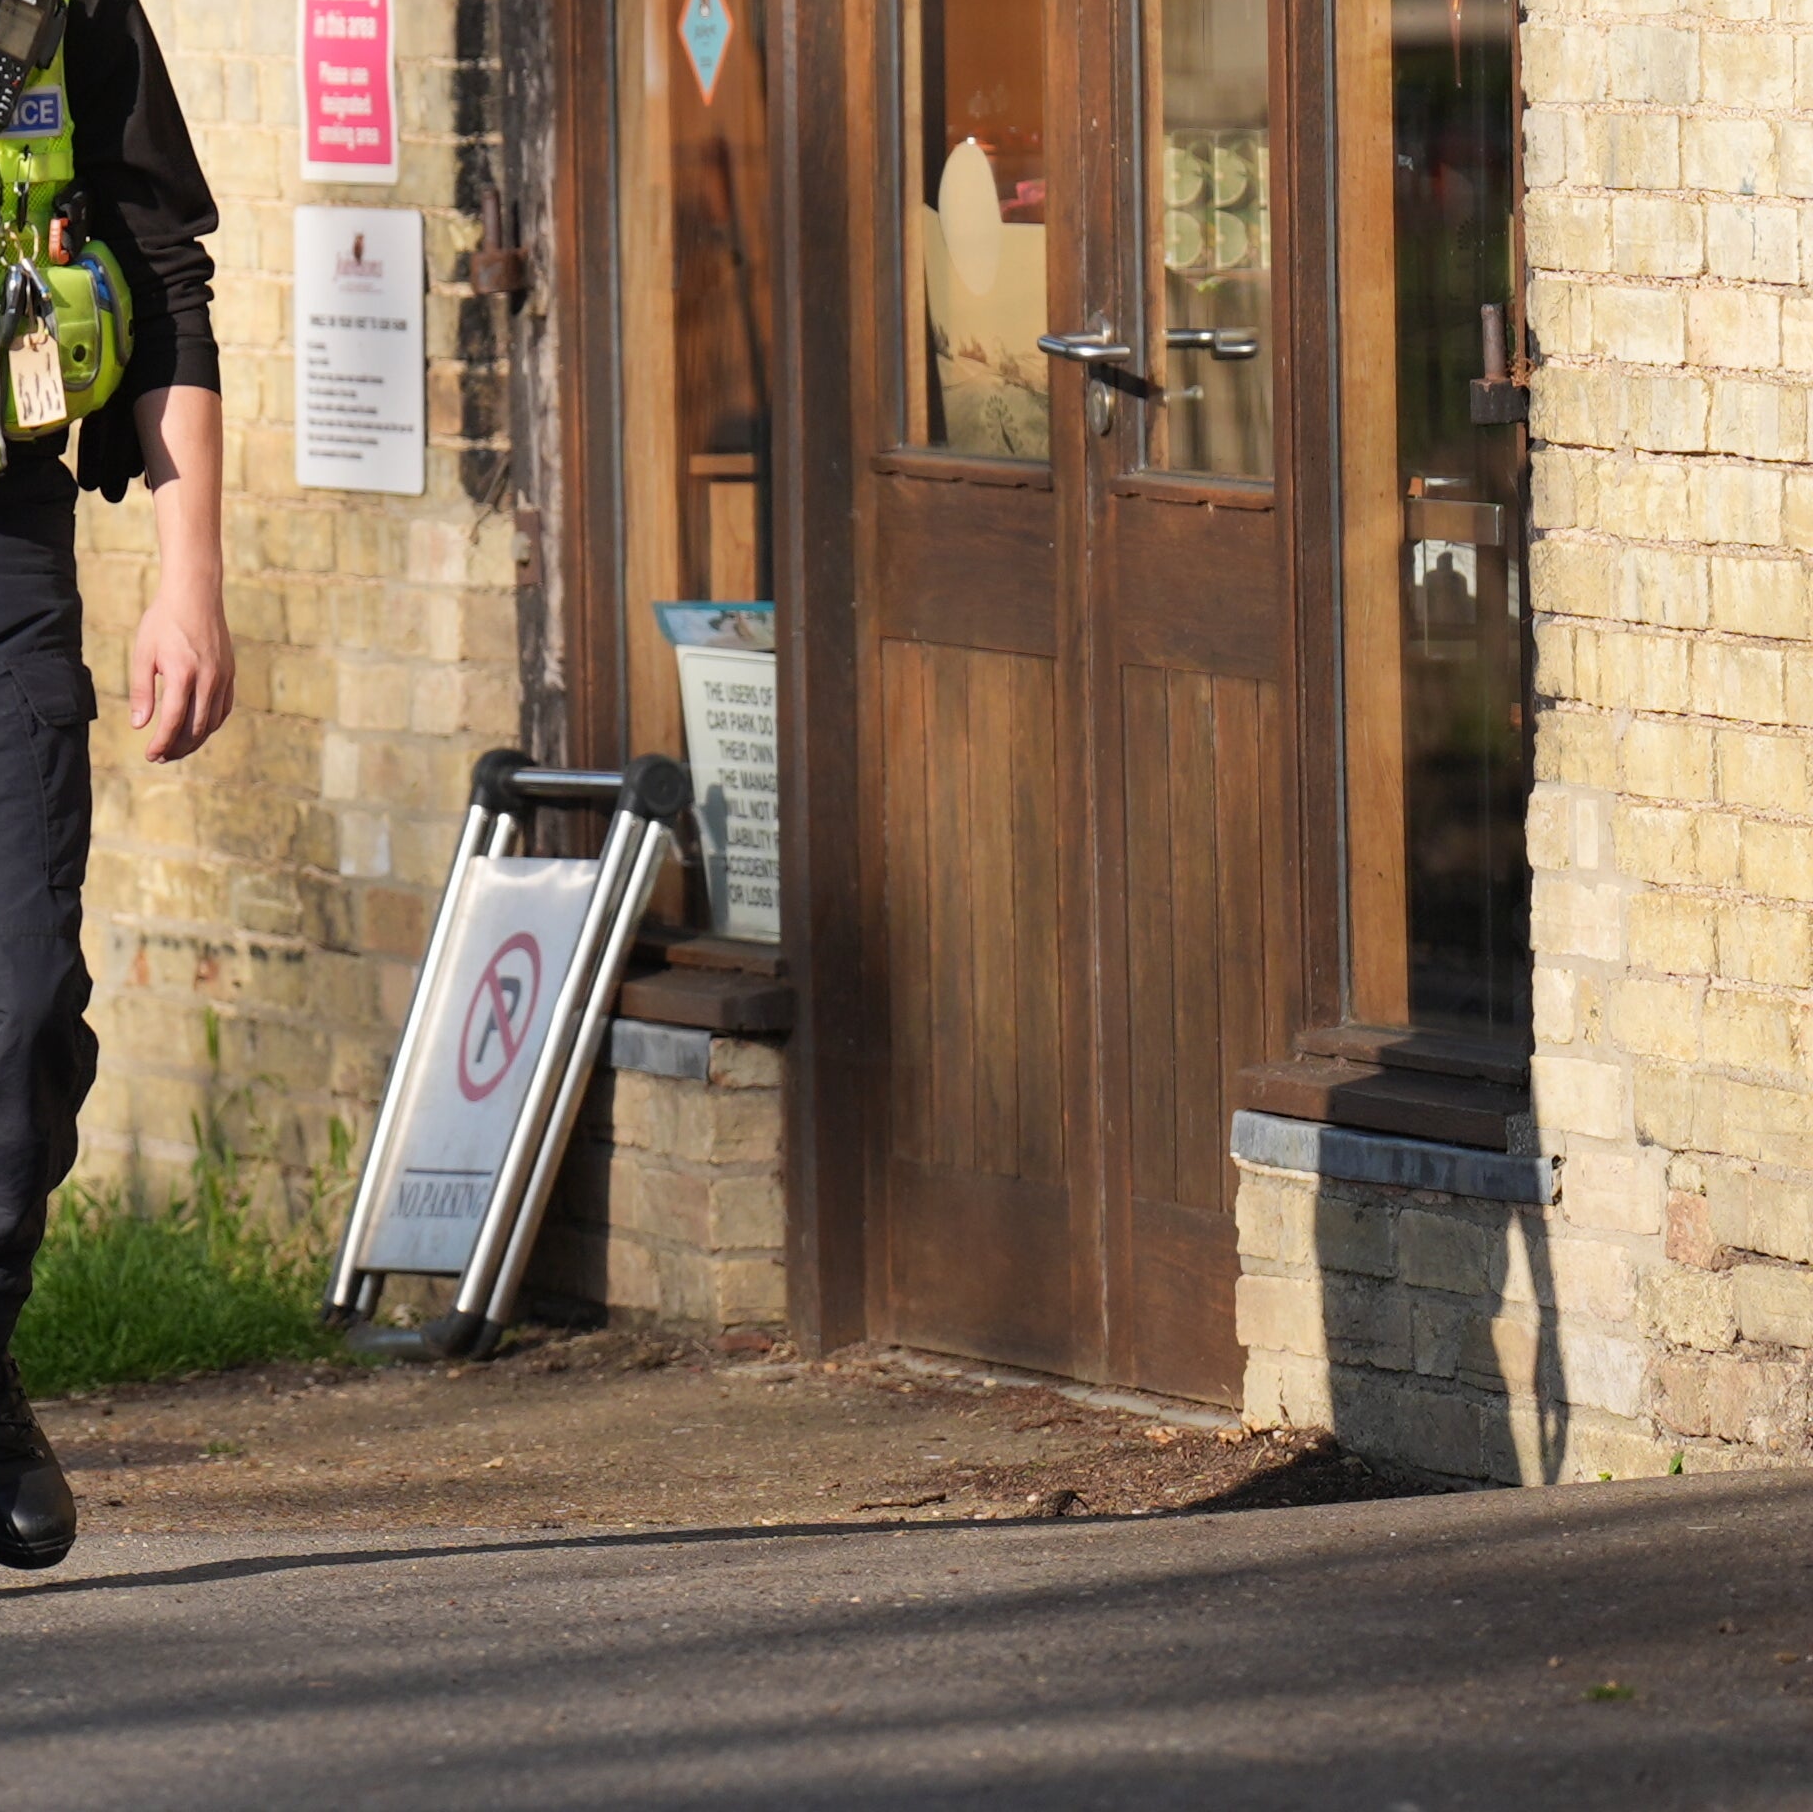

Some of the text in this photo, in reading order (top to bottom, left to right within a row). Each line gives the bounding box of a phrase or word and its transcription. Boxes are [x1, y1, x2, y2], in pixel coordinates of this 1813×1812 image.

[704, 681, 724, 701] THE
[707, 710, 728, 729] CAR
[729, 712, 755, 732] PARK
[718, 739, 774, 763] THEIR OWN
[718, 768, 739, 788] THE
[389, 1181, 489, 1220] NO PARKING
